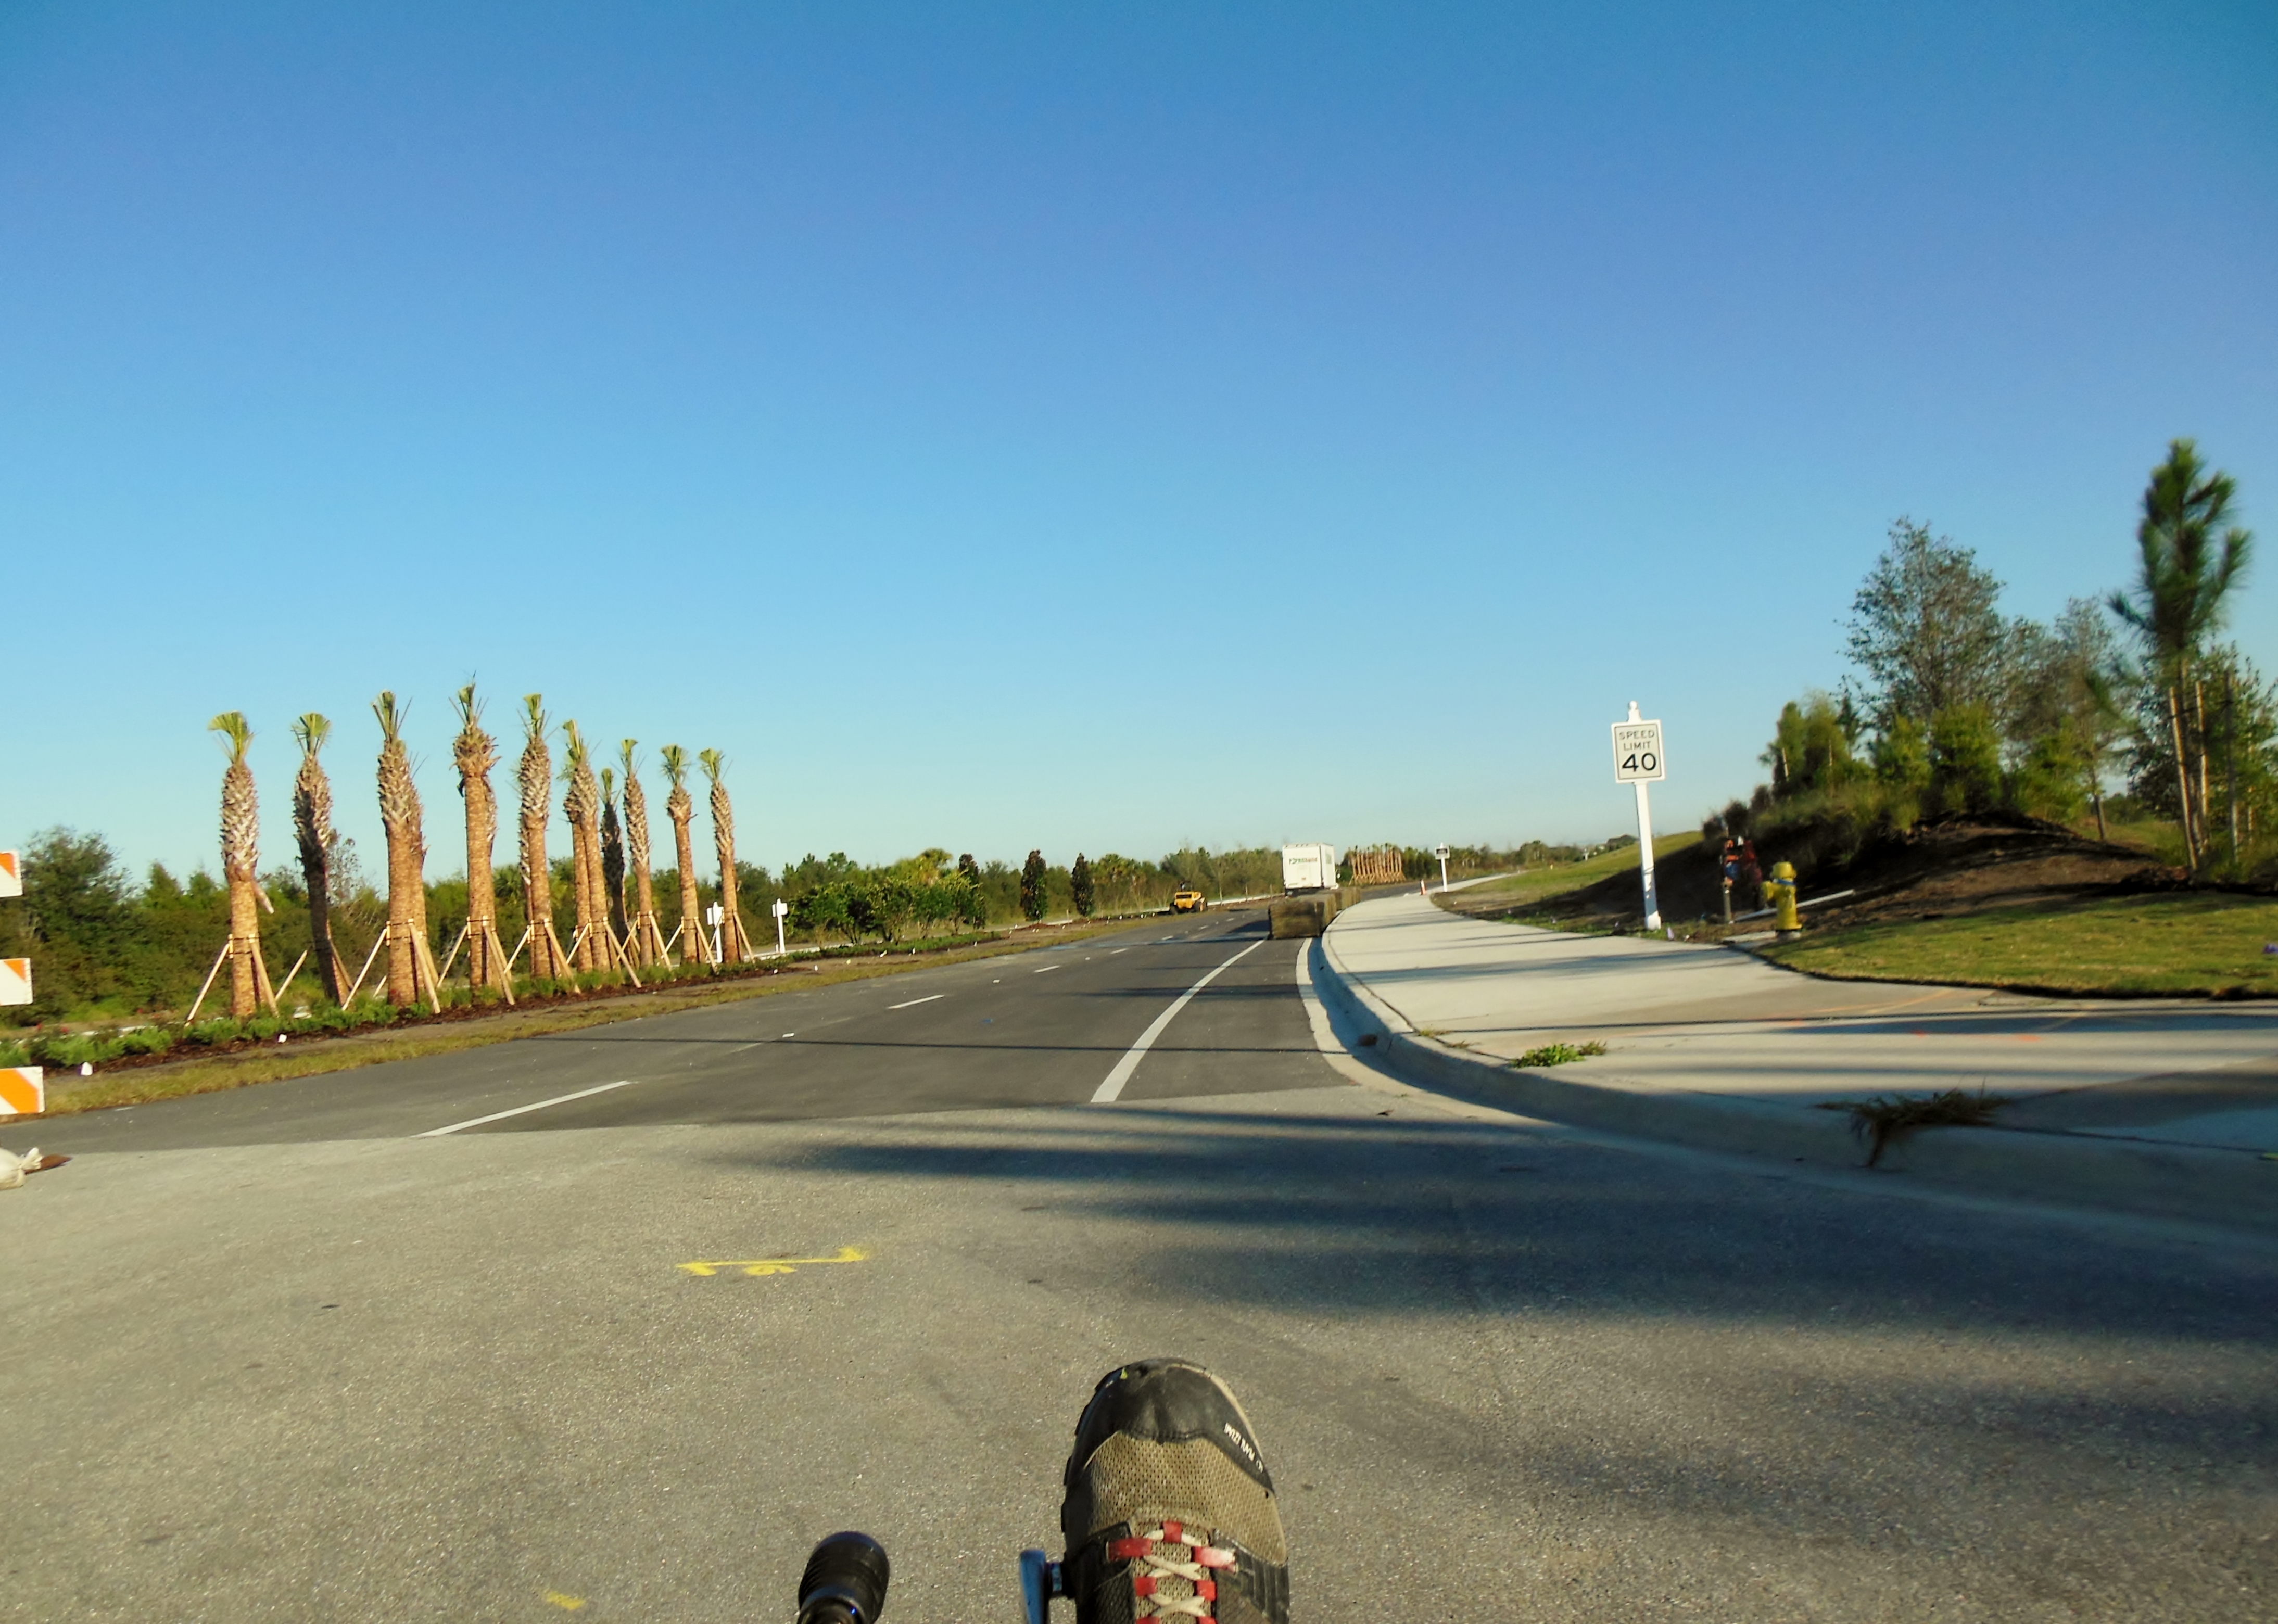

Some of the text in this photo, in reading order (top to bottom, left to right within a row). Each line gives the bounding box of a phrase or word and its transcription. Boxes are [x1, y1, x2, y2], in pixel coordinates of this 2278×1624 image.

[1619, 730, 1655, 740] SPEED
[1623, 741, 1651, 751] LIMIT
[1622, 753, 1656, 772] 40
